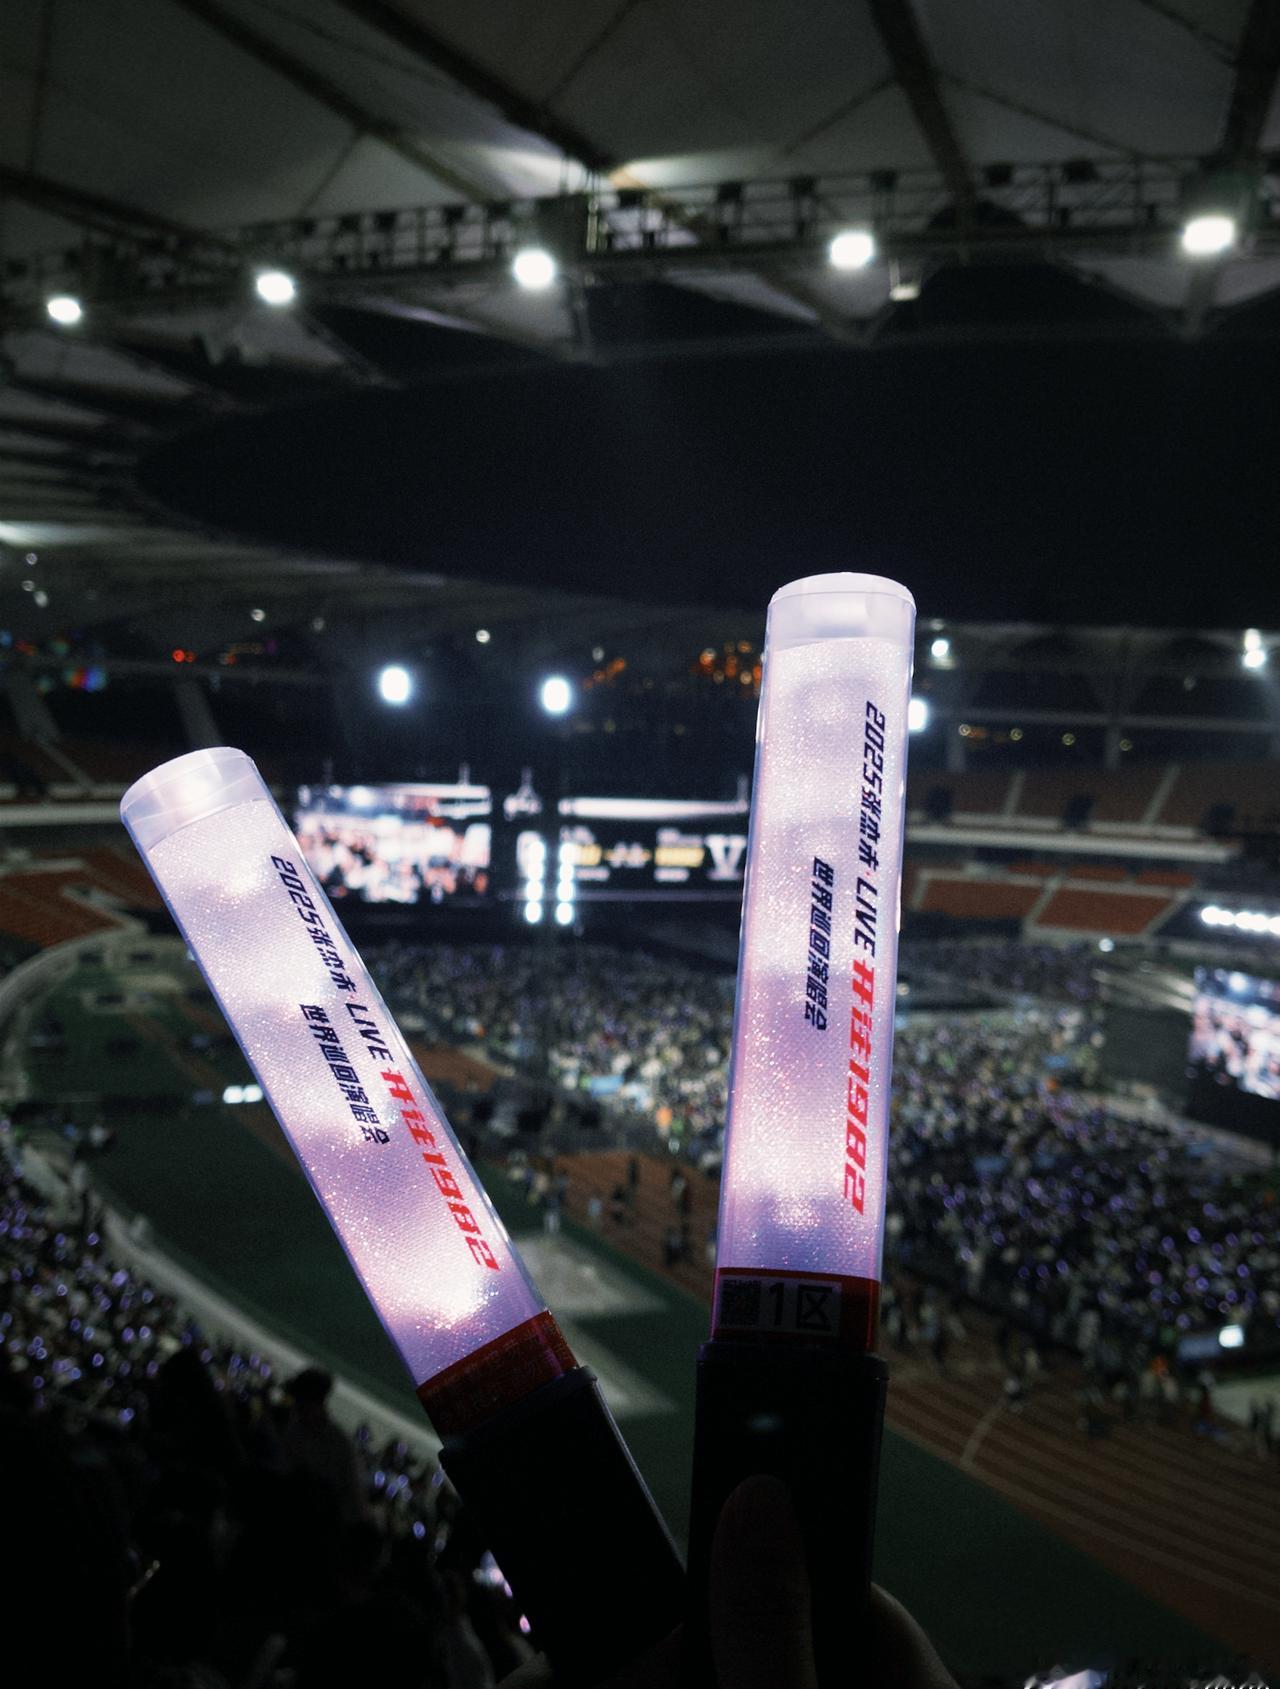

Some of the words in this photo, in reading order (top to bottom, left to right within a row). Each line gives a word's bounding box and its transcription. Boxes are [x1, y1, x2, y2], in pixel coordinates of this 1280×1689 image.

[804, 856, 834, 1031] 世界巡回演唱会
[299, 1003, 391, 1145] 世界巡回演唱会
[380, 1066, 501, 1271] 开往1982
[844, 958, 875, 1215] 开往1982
